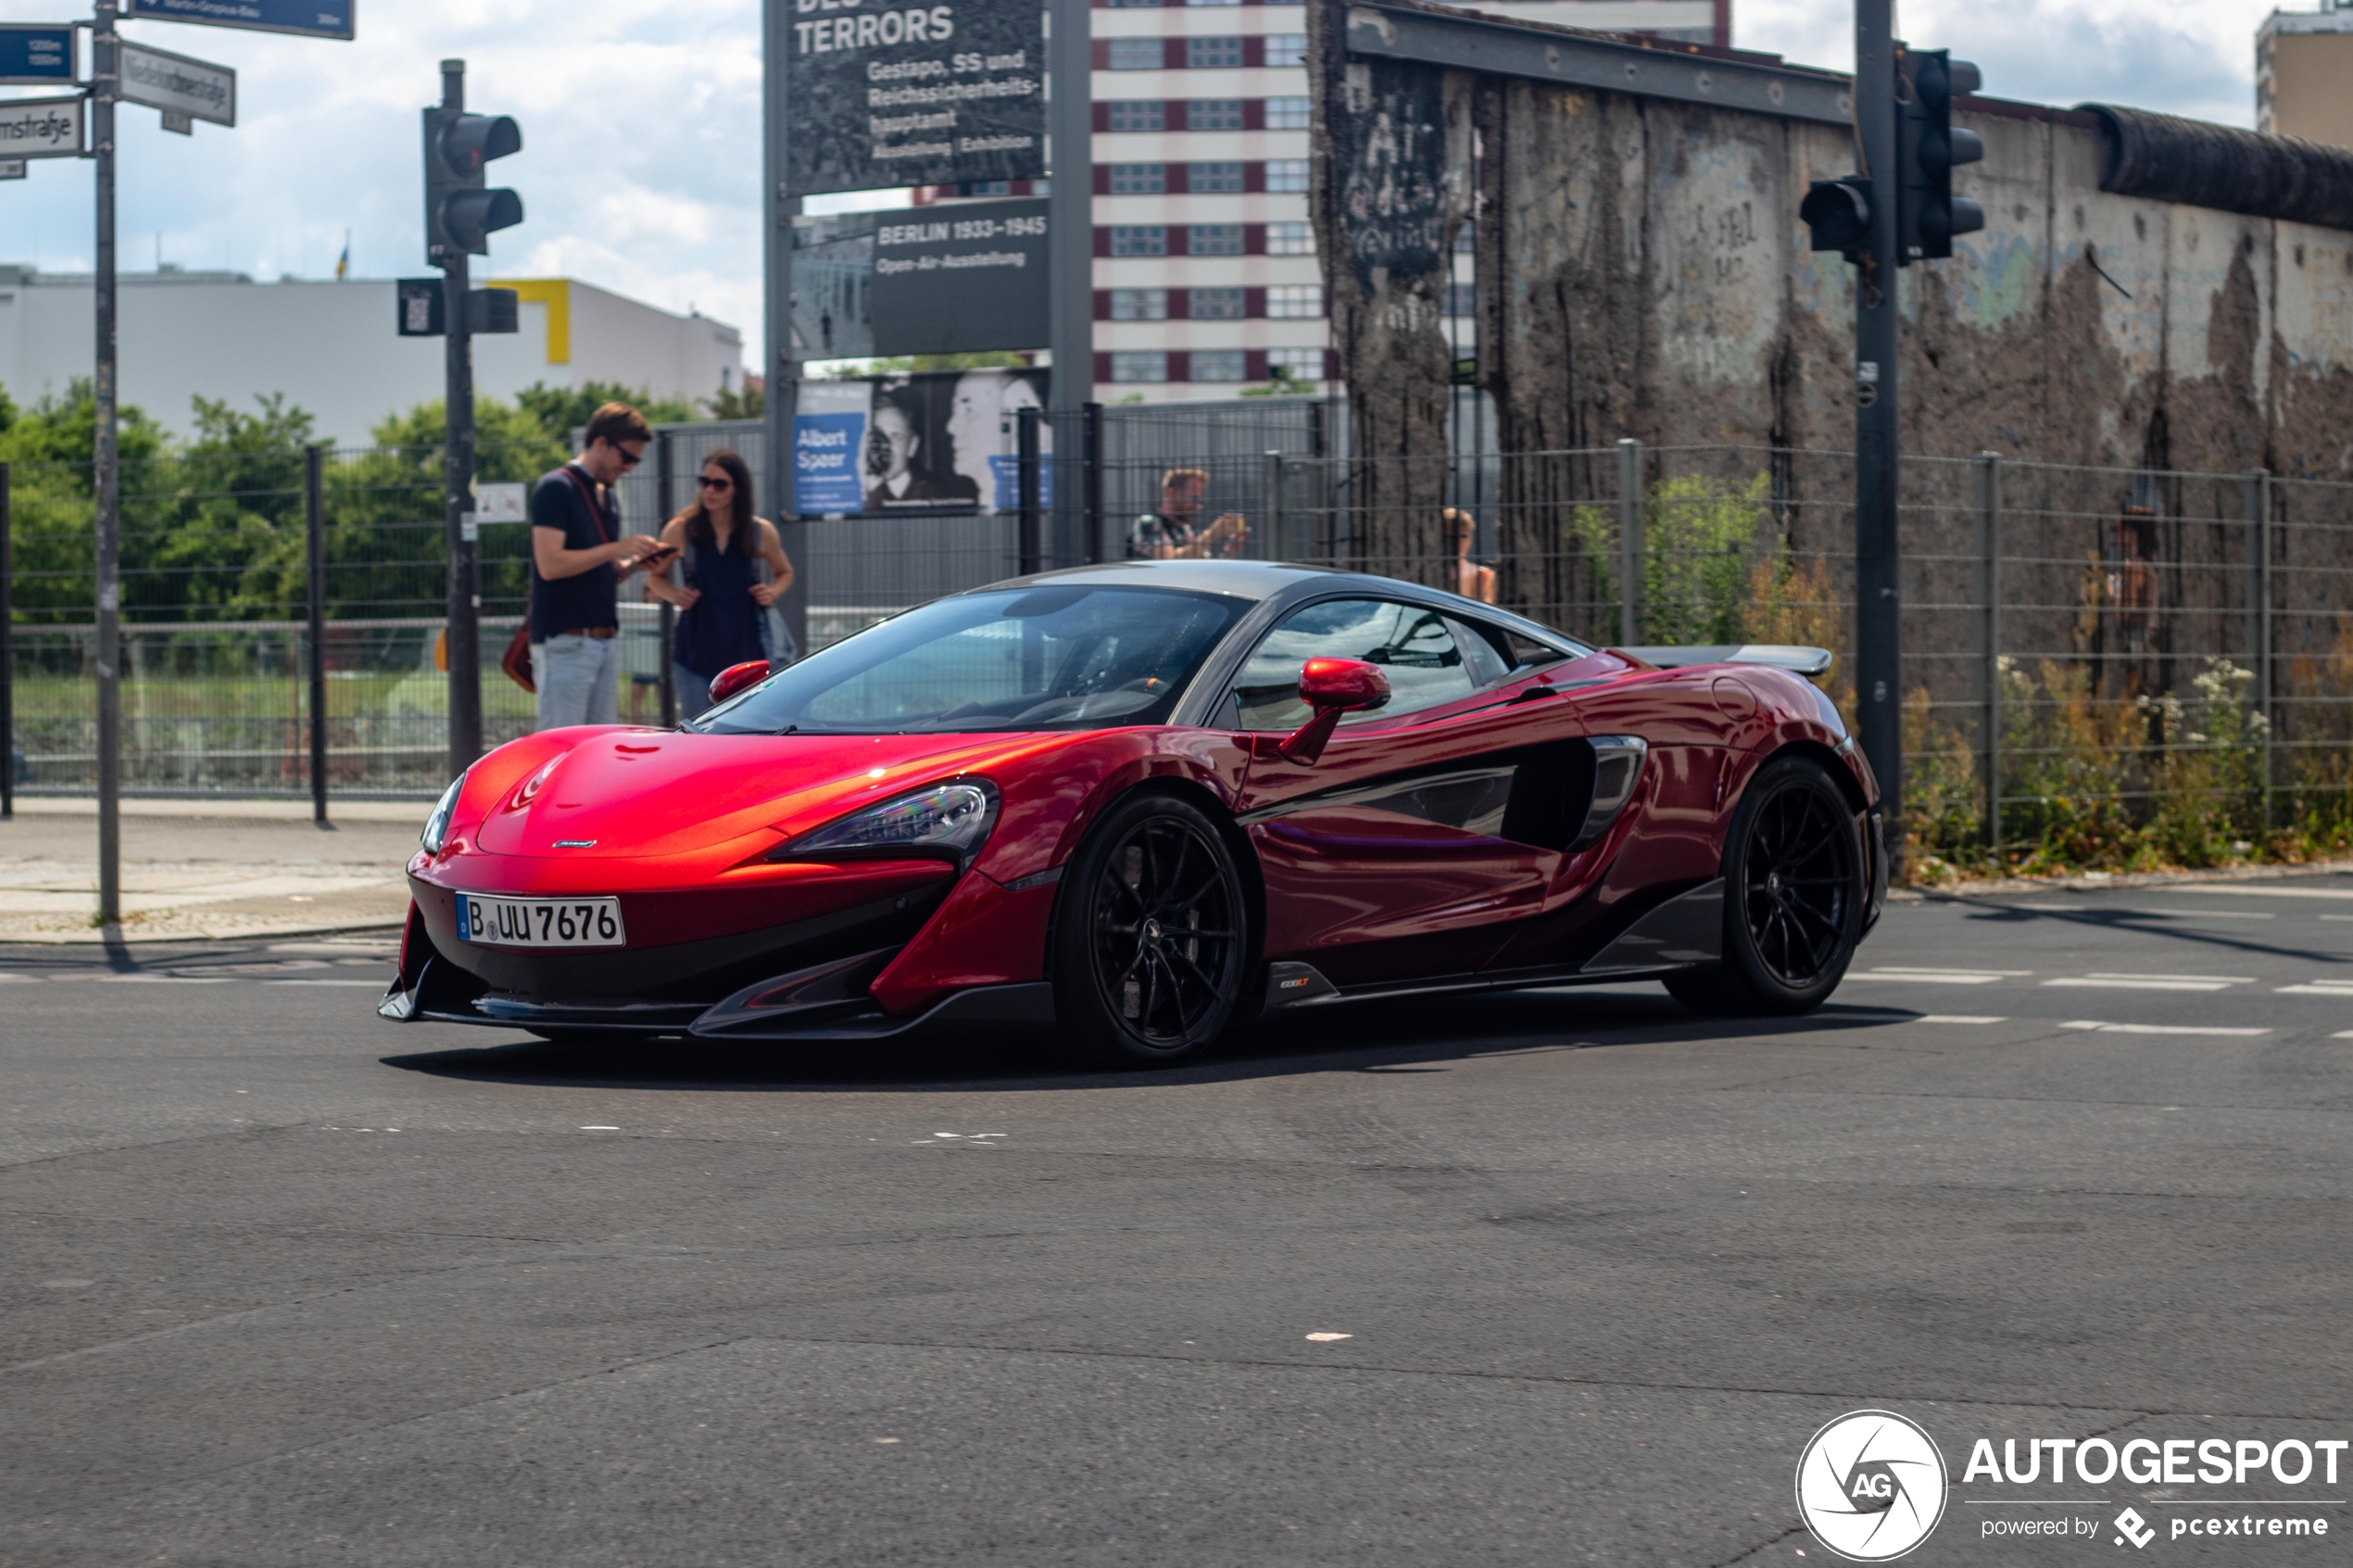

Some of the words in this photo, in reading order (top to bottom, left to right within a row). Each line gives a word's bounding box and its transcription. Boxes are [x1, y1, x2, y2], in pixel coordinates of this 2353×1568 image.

[795, 6, 954, 54] TERRORS
[867, 59, 949, 82] Gestapo,
[952, 52, 982, 73] SS
[986, 49, 1026, 69] und
[868, 77, 1039, 107] Reichssicherheits-
[878, 222, 950, 245] BERLIN
[876, 251, 1026, 274] Open-Air-Ausstellung
[798, 429, 848, 447] Albert
[797, 450, 846, 472] Speer
[469, 901, 484, 935] B
[497, 904, 531, 940] UU
[535, 905, 616, 941] 7676
[1280, 978, 1309, 989] 600LT
